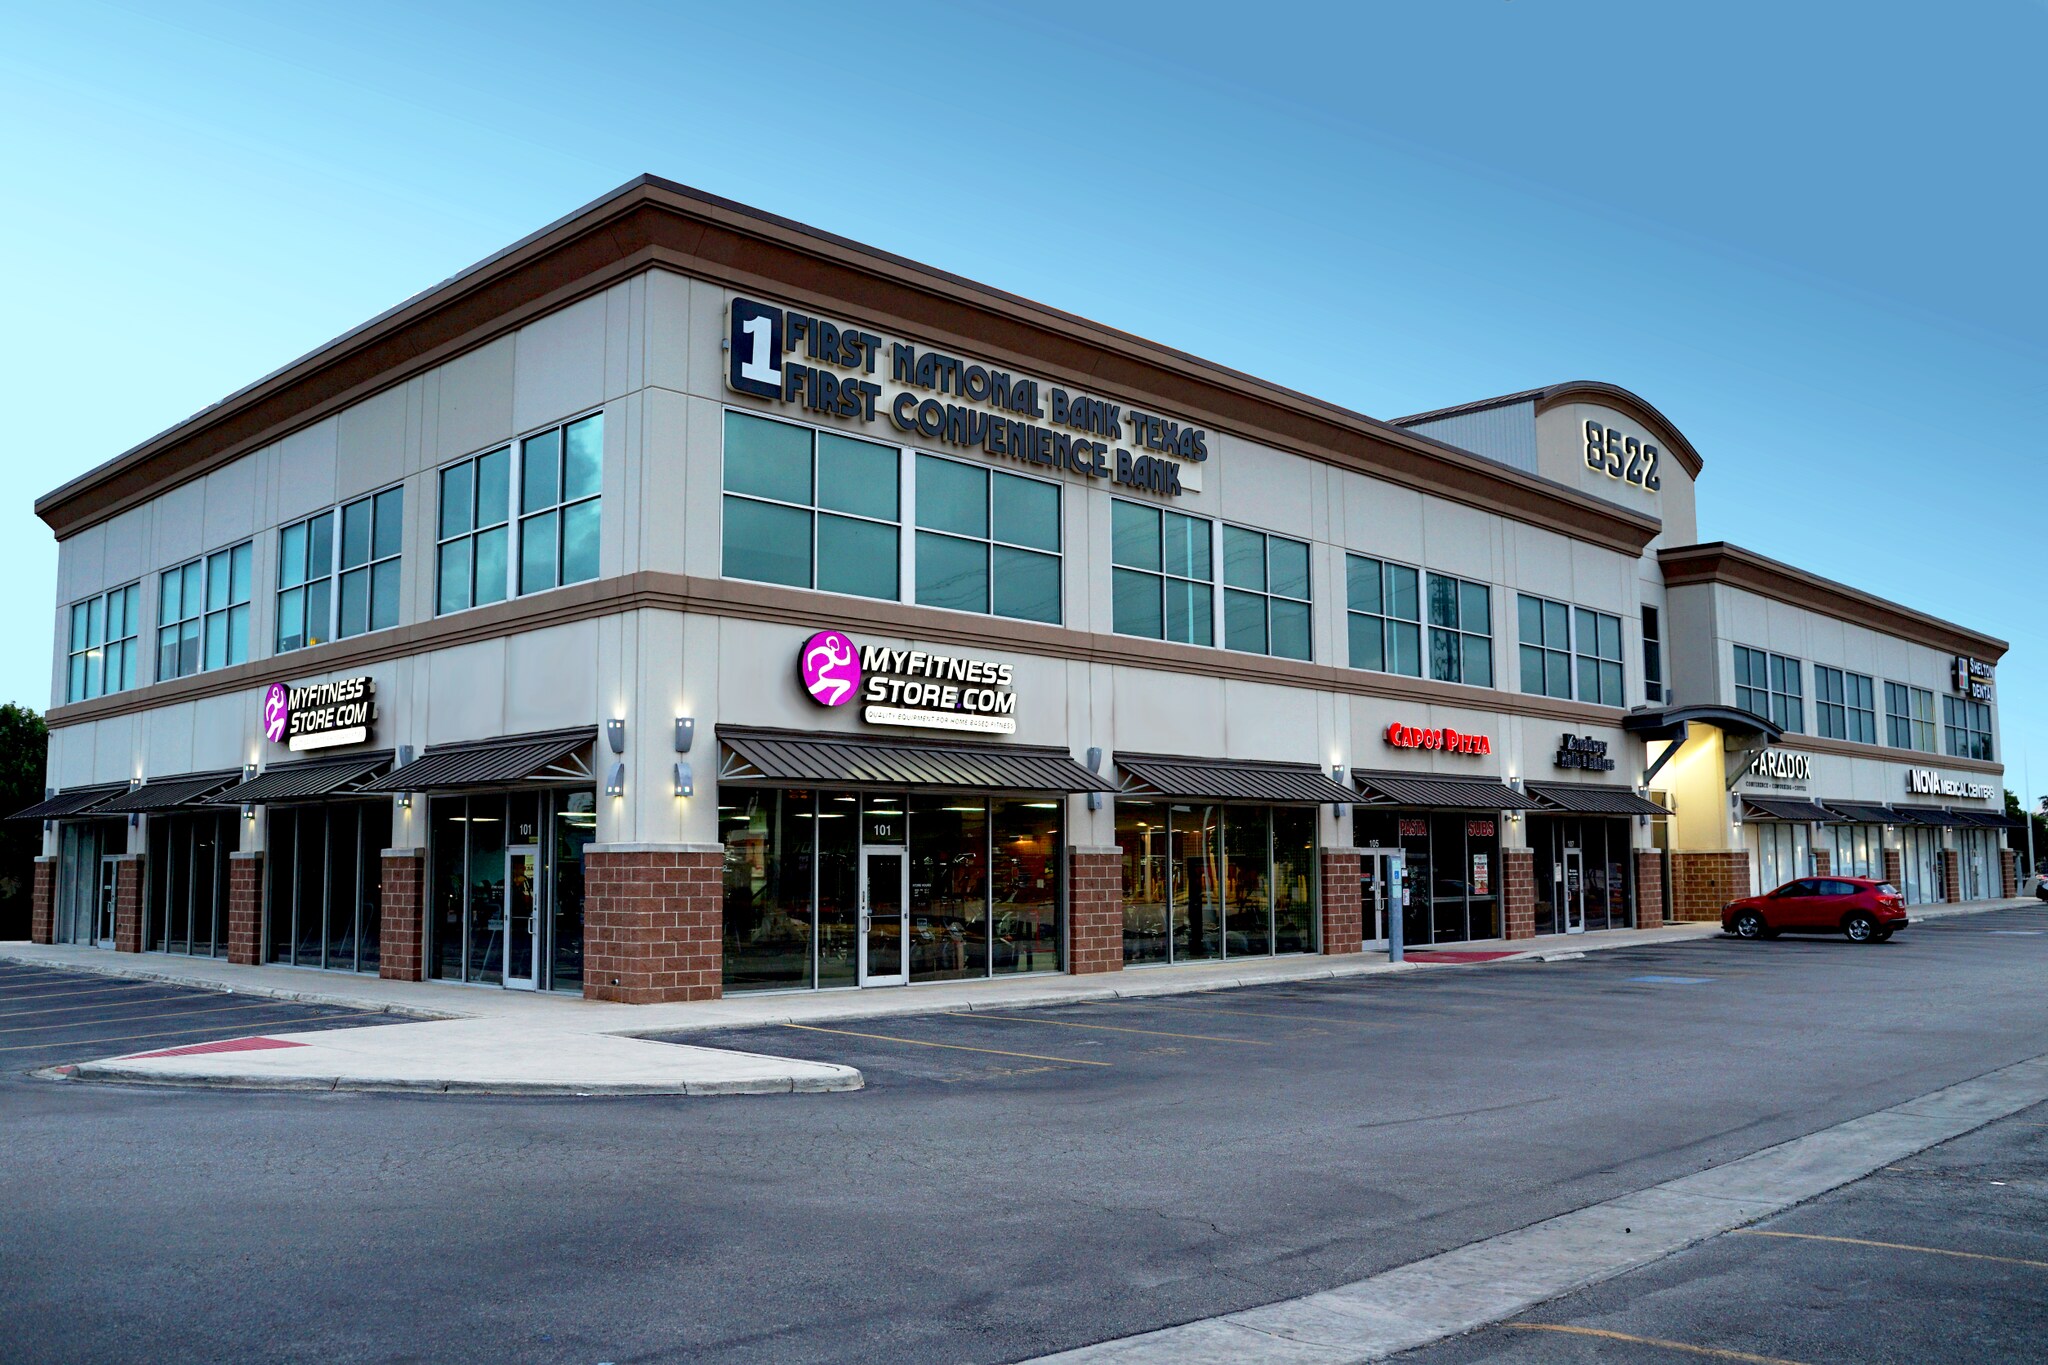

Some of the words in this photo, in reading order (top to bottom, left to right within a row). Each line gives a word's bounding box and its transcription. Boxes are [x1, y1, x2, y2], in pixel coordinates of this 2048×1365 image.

[742, 315, 781, 387] 1
[785, 311, 882, 374] FIRST
[891, 342, 1044, 418] NATIONAL
[1050, 387, 1122, 440] BANK
[1129, 410, 1208, 462] TEXAS
[784, 362, 882, 422] FIRST
[890, 391, 1108, 477] CONVENIENCE
[1113, 447, 1183, 496] BANK
[1582, 419, 1661, 493] 8522
[863, 645, 1014, 686] MYFITNESS
[1969, 657, 1993, 678] SHELTON
[288, 676, 366, 711] MYFITNESS
[866, 676, 1017, 714] STORE.COM
[1972, 683, 1994, 701] DENTAL
[290, 702, 368, 734] STORE.COM
[867, 710, 895, 719] QUALITY
[897, 713, 935, 722] EQUIPMENT
[950, 717, 968, 726] HOME
[969, 719, 989, 728] BASED
[990, 721, 1014, 730] FITNESS
[1387, 721, 1442, 750] CAPOS
[1443, 727, 1492, 755] PIZZA
[1912, 769, 1941, 794] NOVA
[1940, 779, 1968, 798] MEDICAL
[1968, 783, 1995, 799] CENTERS
[519, 824, 532, 835] 101
[873, 824, 891, 837] 101
[1369, 839, 1380, 848] 105
[1399, 818, 1427, 836] PASTA
[1467, 820, 1494, 837] SUBS
